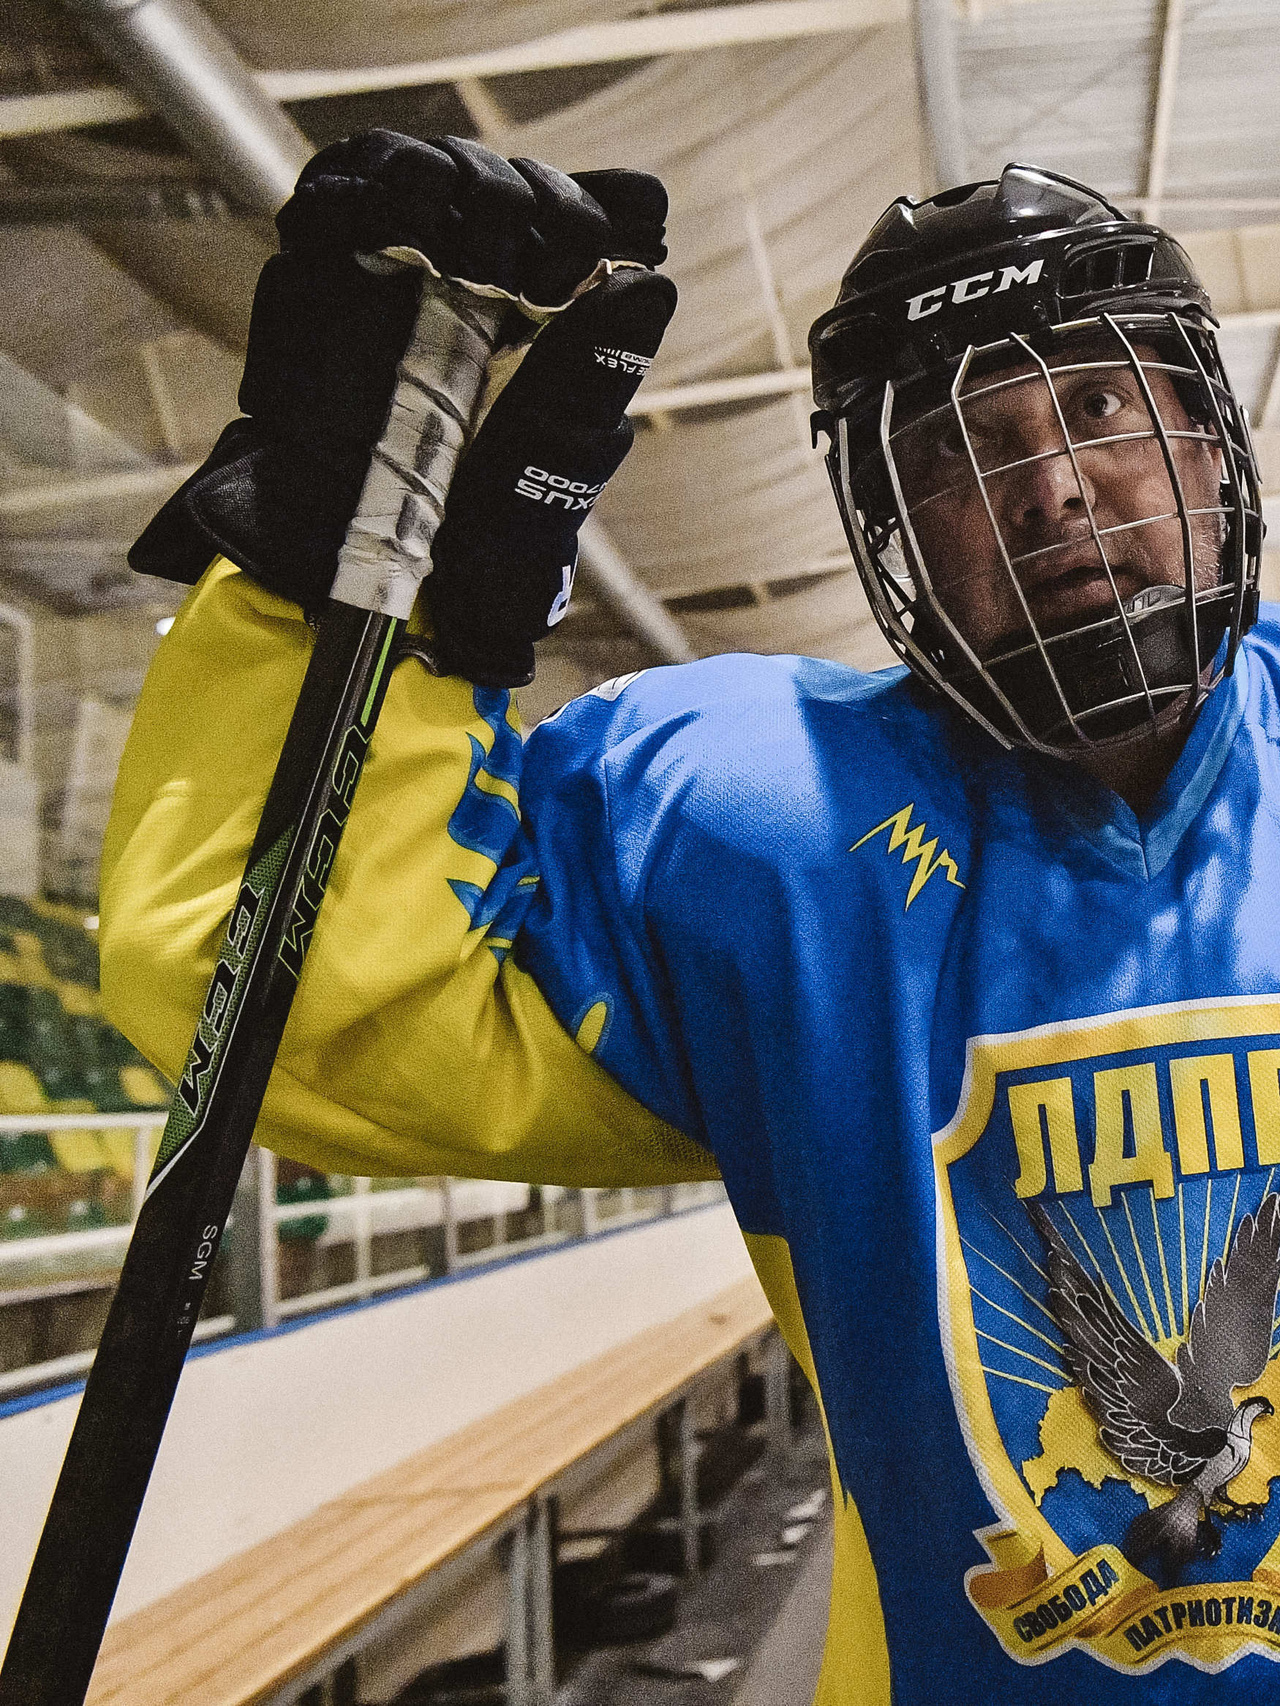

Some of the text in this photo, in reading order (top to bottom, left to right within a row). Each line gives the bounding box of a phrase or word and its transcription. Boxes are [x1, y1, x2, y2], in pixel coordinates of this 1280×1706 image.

[905, 259, 1044, 321] CCM
[514, 479, 596, 510] XUS
[278, 724, 373, 982] CCM
[178, 881, 267, 1117] CCM
[187, 1223, 218, 1281] SGM
[1013, 1558, 1120, 1644] СВОБОДА
